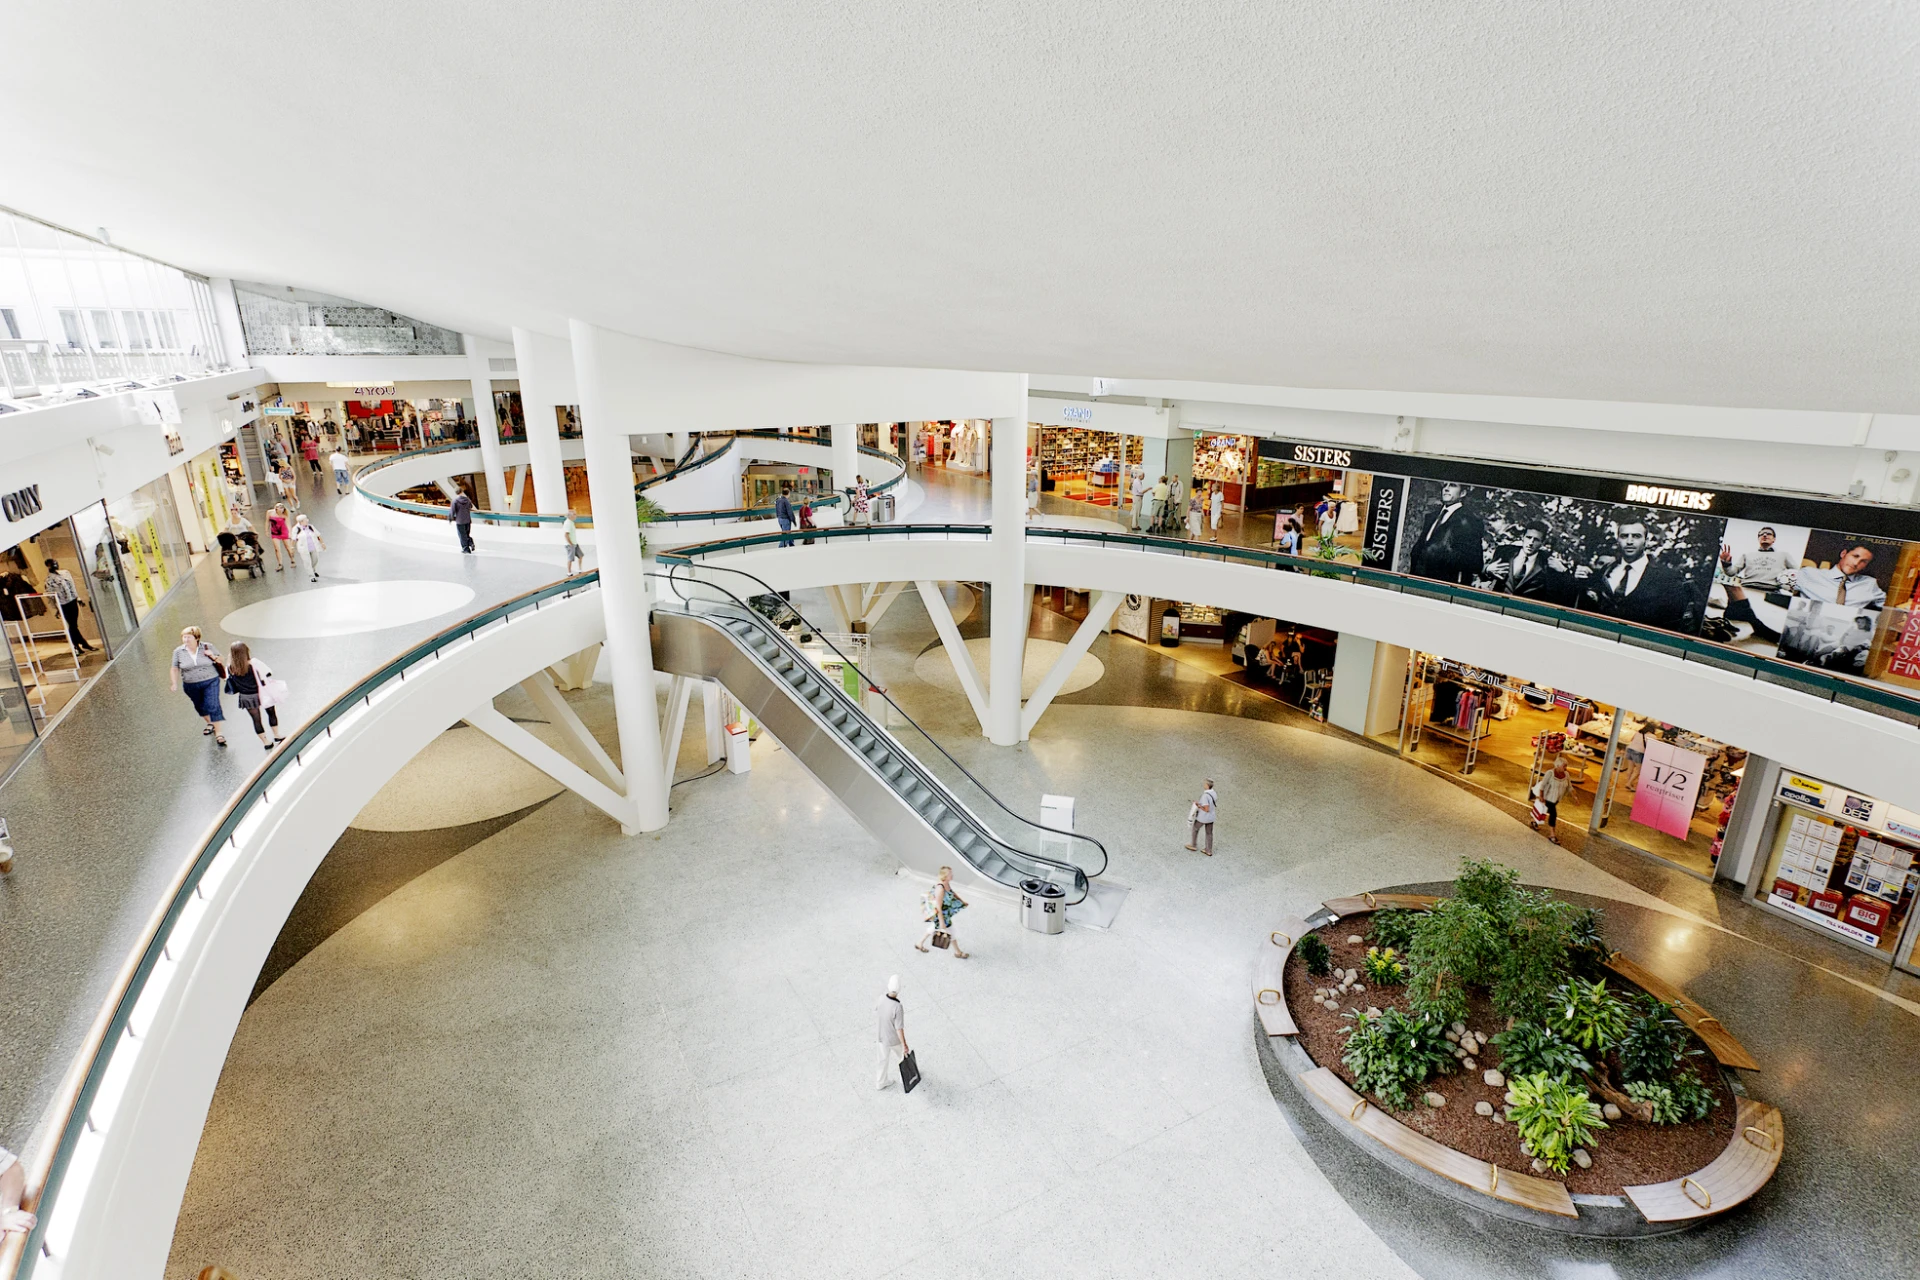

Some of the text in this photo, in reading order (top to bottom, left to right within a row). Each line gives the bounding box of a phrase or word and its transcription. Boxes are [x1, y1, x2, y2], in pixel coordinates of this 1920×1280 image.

[354, 386, 396, 396] 4YOU
[1063, 406, 1092, 419] GRAND
[1210, 438, 1236, 447] GRAND
[1294, 445, 1351, 467] SISTERS
[1, 484, 43, 523] ONLY
[1625, 484, 1712, 511] BROTHERS
[1371, 488, 1395, 561] SISTERS
[1433, 657, 1591, 712] TWILFIT
[1650, 765, 1688, 791] 1/2
[1645, 783, 1686, 802] reapriset
[1783, 790, 1812, 804] apollo
[1819, 900, 1835, 910] BIG
[1857, 908, 1877, 921] BIG
